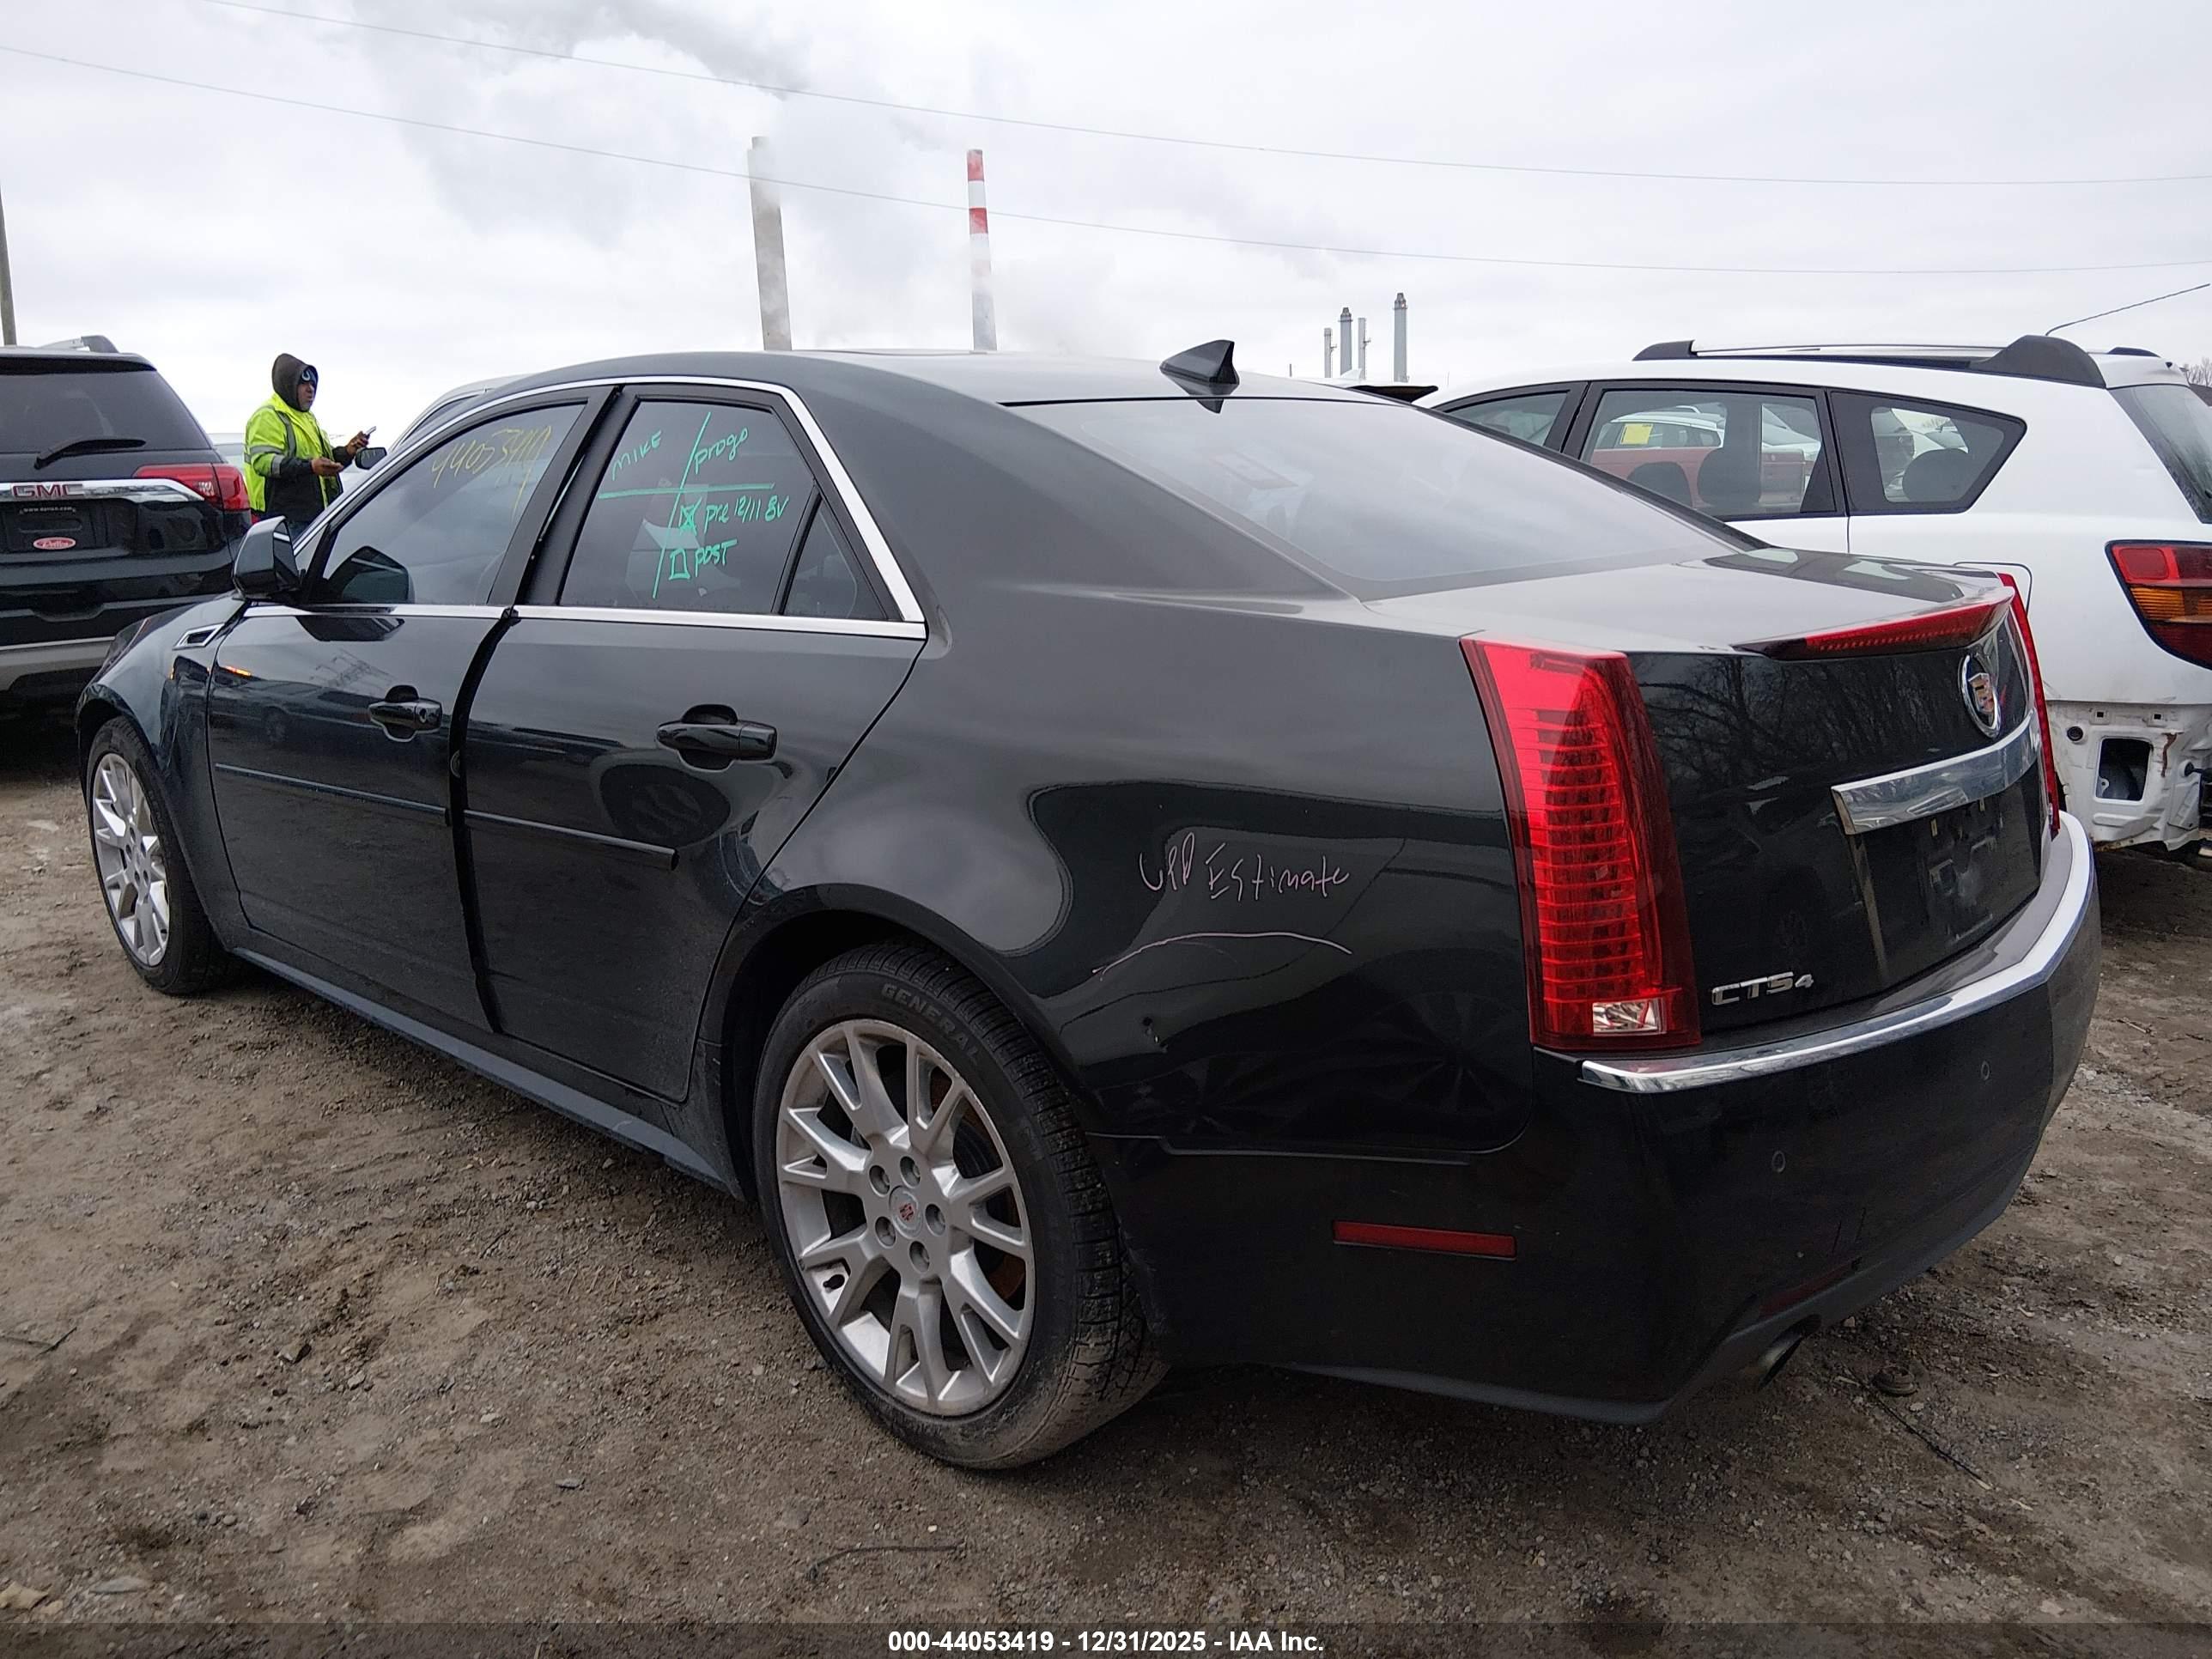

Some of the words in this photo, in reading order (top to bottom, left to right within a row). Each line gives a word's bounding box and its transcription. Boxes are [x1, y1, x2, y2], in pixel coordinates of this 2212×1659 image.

[612, 430, 661, 481] MIKE
[12, 484, 84, 498] GMC
[1206, 842, 1350, 902] Estimate
[881, 982, 981, 1066] GENERAL
